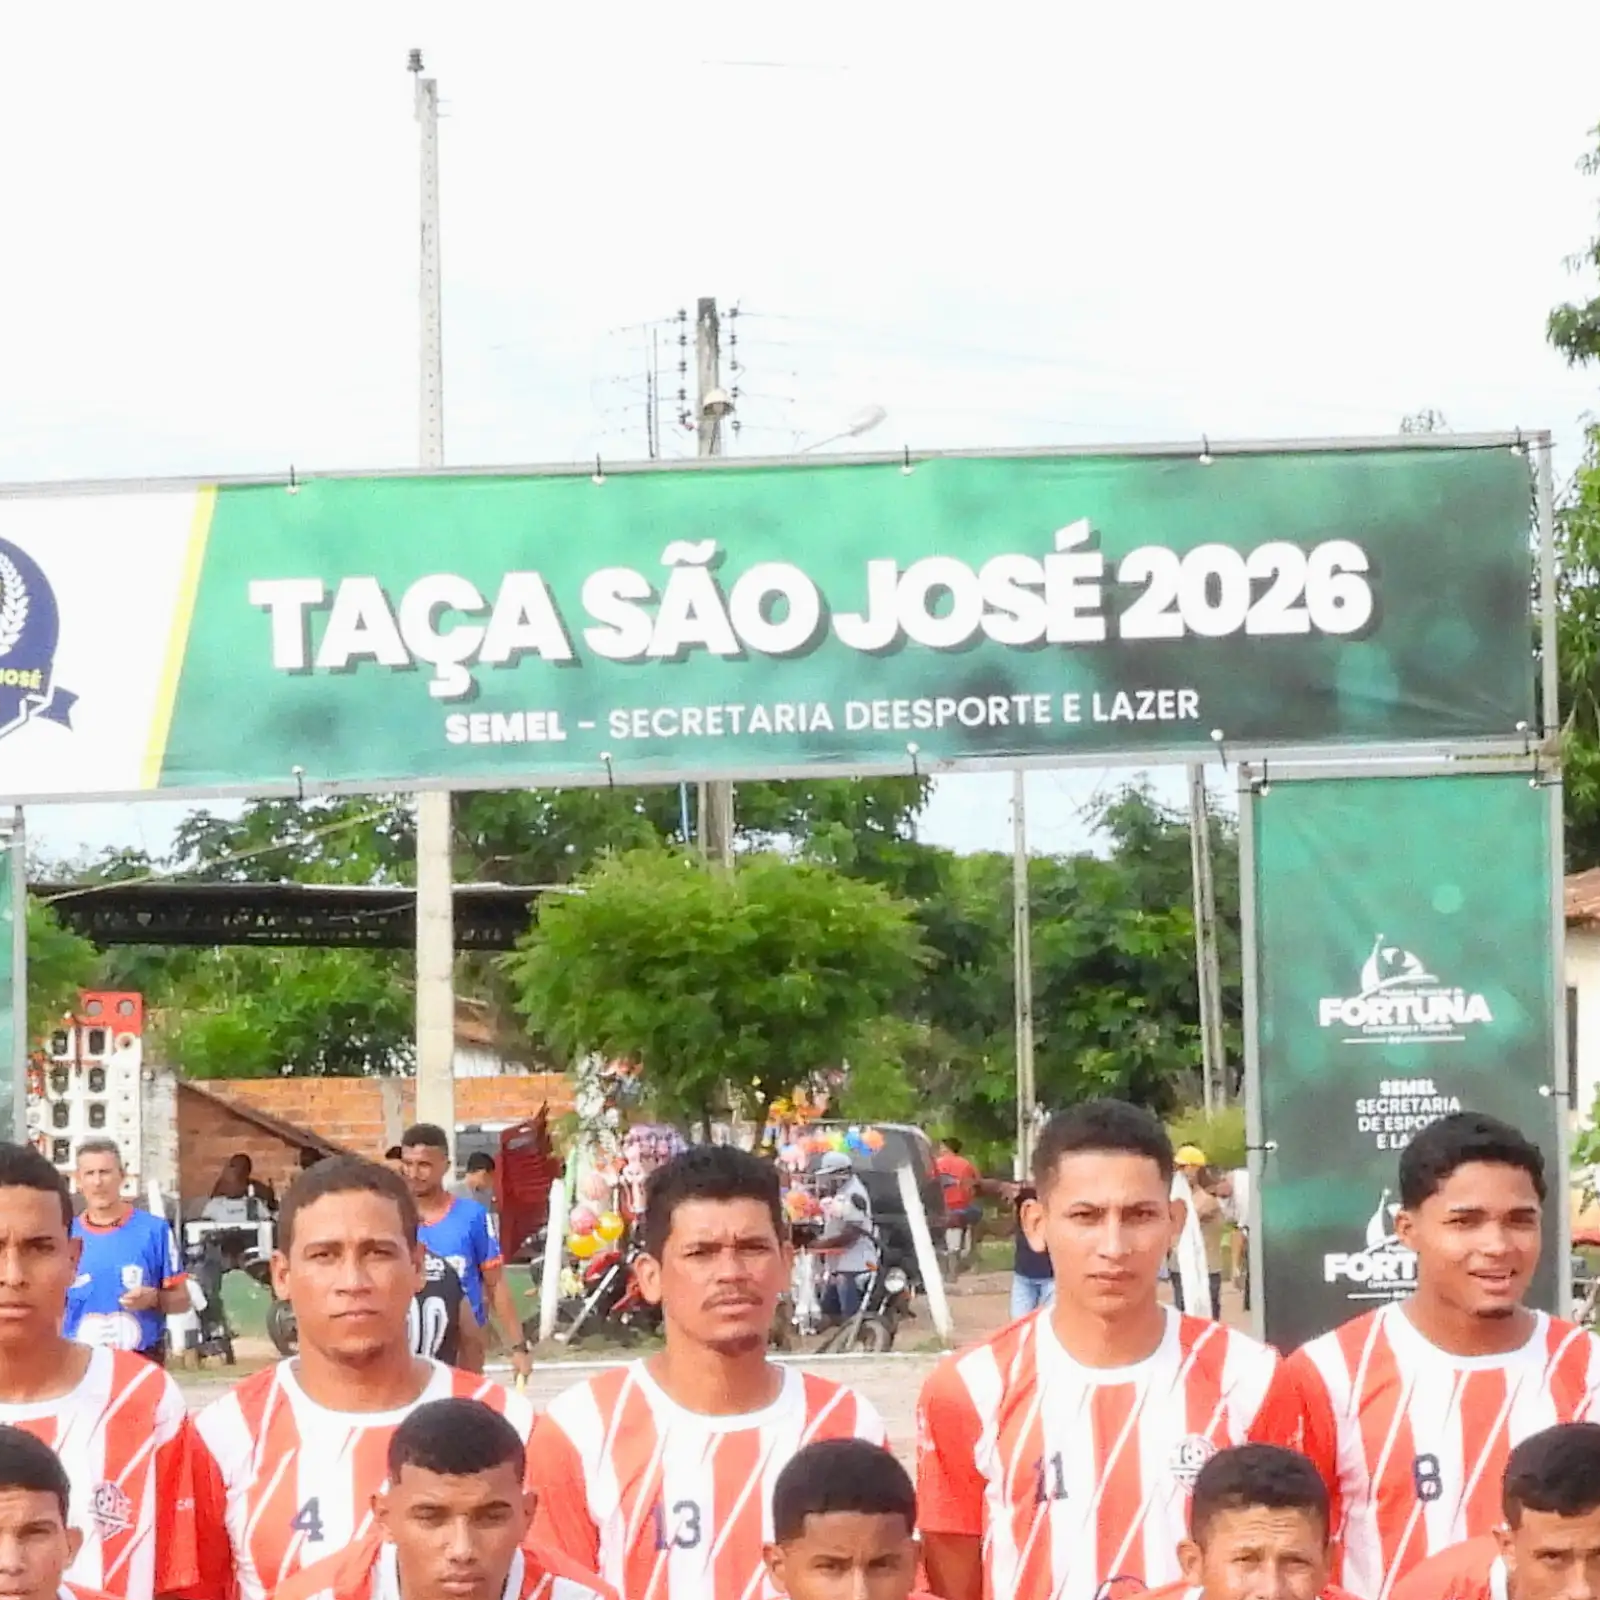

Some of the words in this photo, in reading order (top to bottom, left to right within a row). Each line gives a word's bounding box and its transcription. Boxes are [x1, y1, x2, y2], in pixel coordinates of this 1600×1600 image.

[249, 570, 574, 698] TAÇA
[582, 540, 821, 660] SÃO
[832, 517, 1105, 649] JOSÉ
[1119, 539, 1374, 639] 2026
[445, 711, 567, 744] SEMEL
[608, 702, 834, 739] SECRETARIA
[1062, 693, 1081, 722] E
[1092, 688, 1200, 722] LAZER
[1319, 994, 1493, 1027] FORTUNA
[1355, 1096, 1461, 1114] SECRETARIA
[1380, 1079, 1437, 1096] SEMEL
[1358, 1116, 1381, 1132] DE
[1376, 1133, 1387, 1149] E
[1324, 1252, 1418, 1282] FORT
[1033, 1451, 1069, 1503] 11
[1414, 1452, 1443, 1501] 8
[290, 1496, 324, 1543] 4
[653, 1499, 701, 1551] 13
